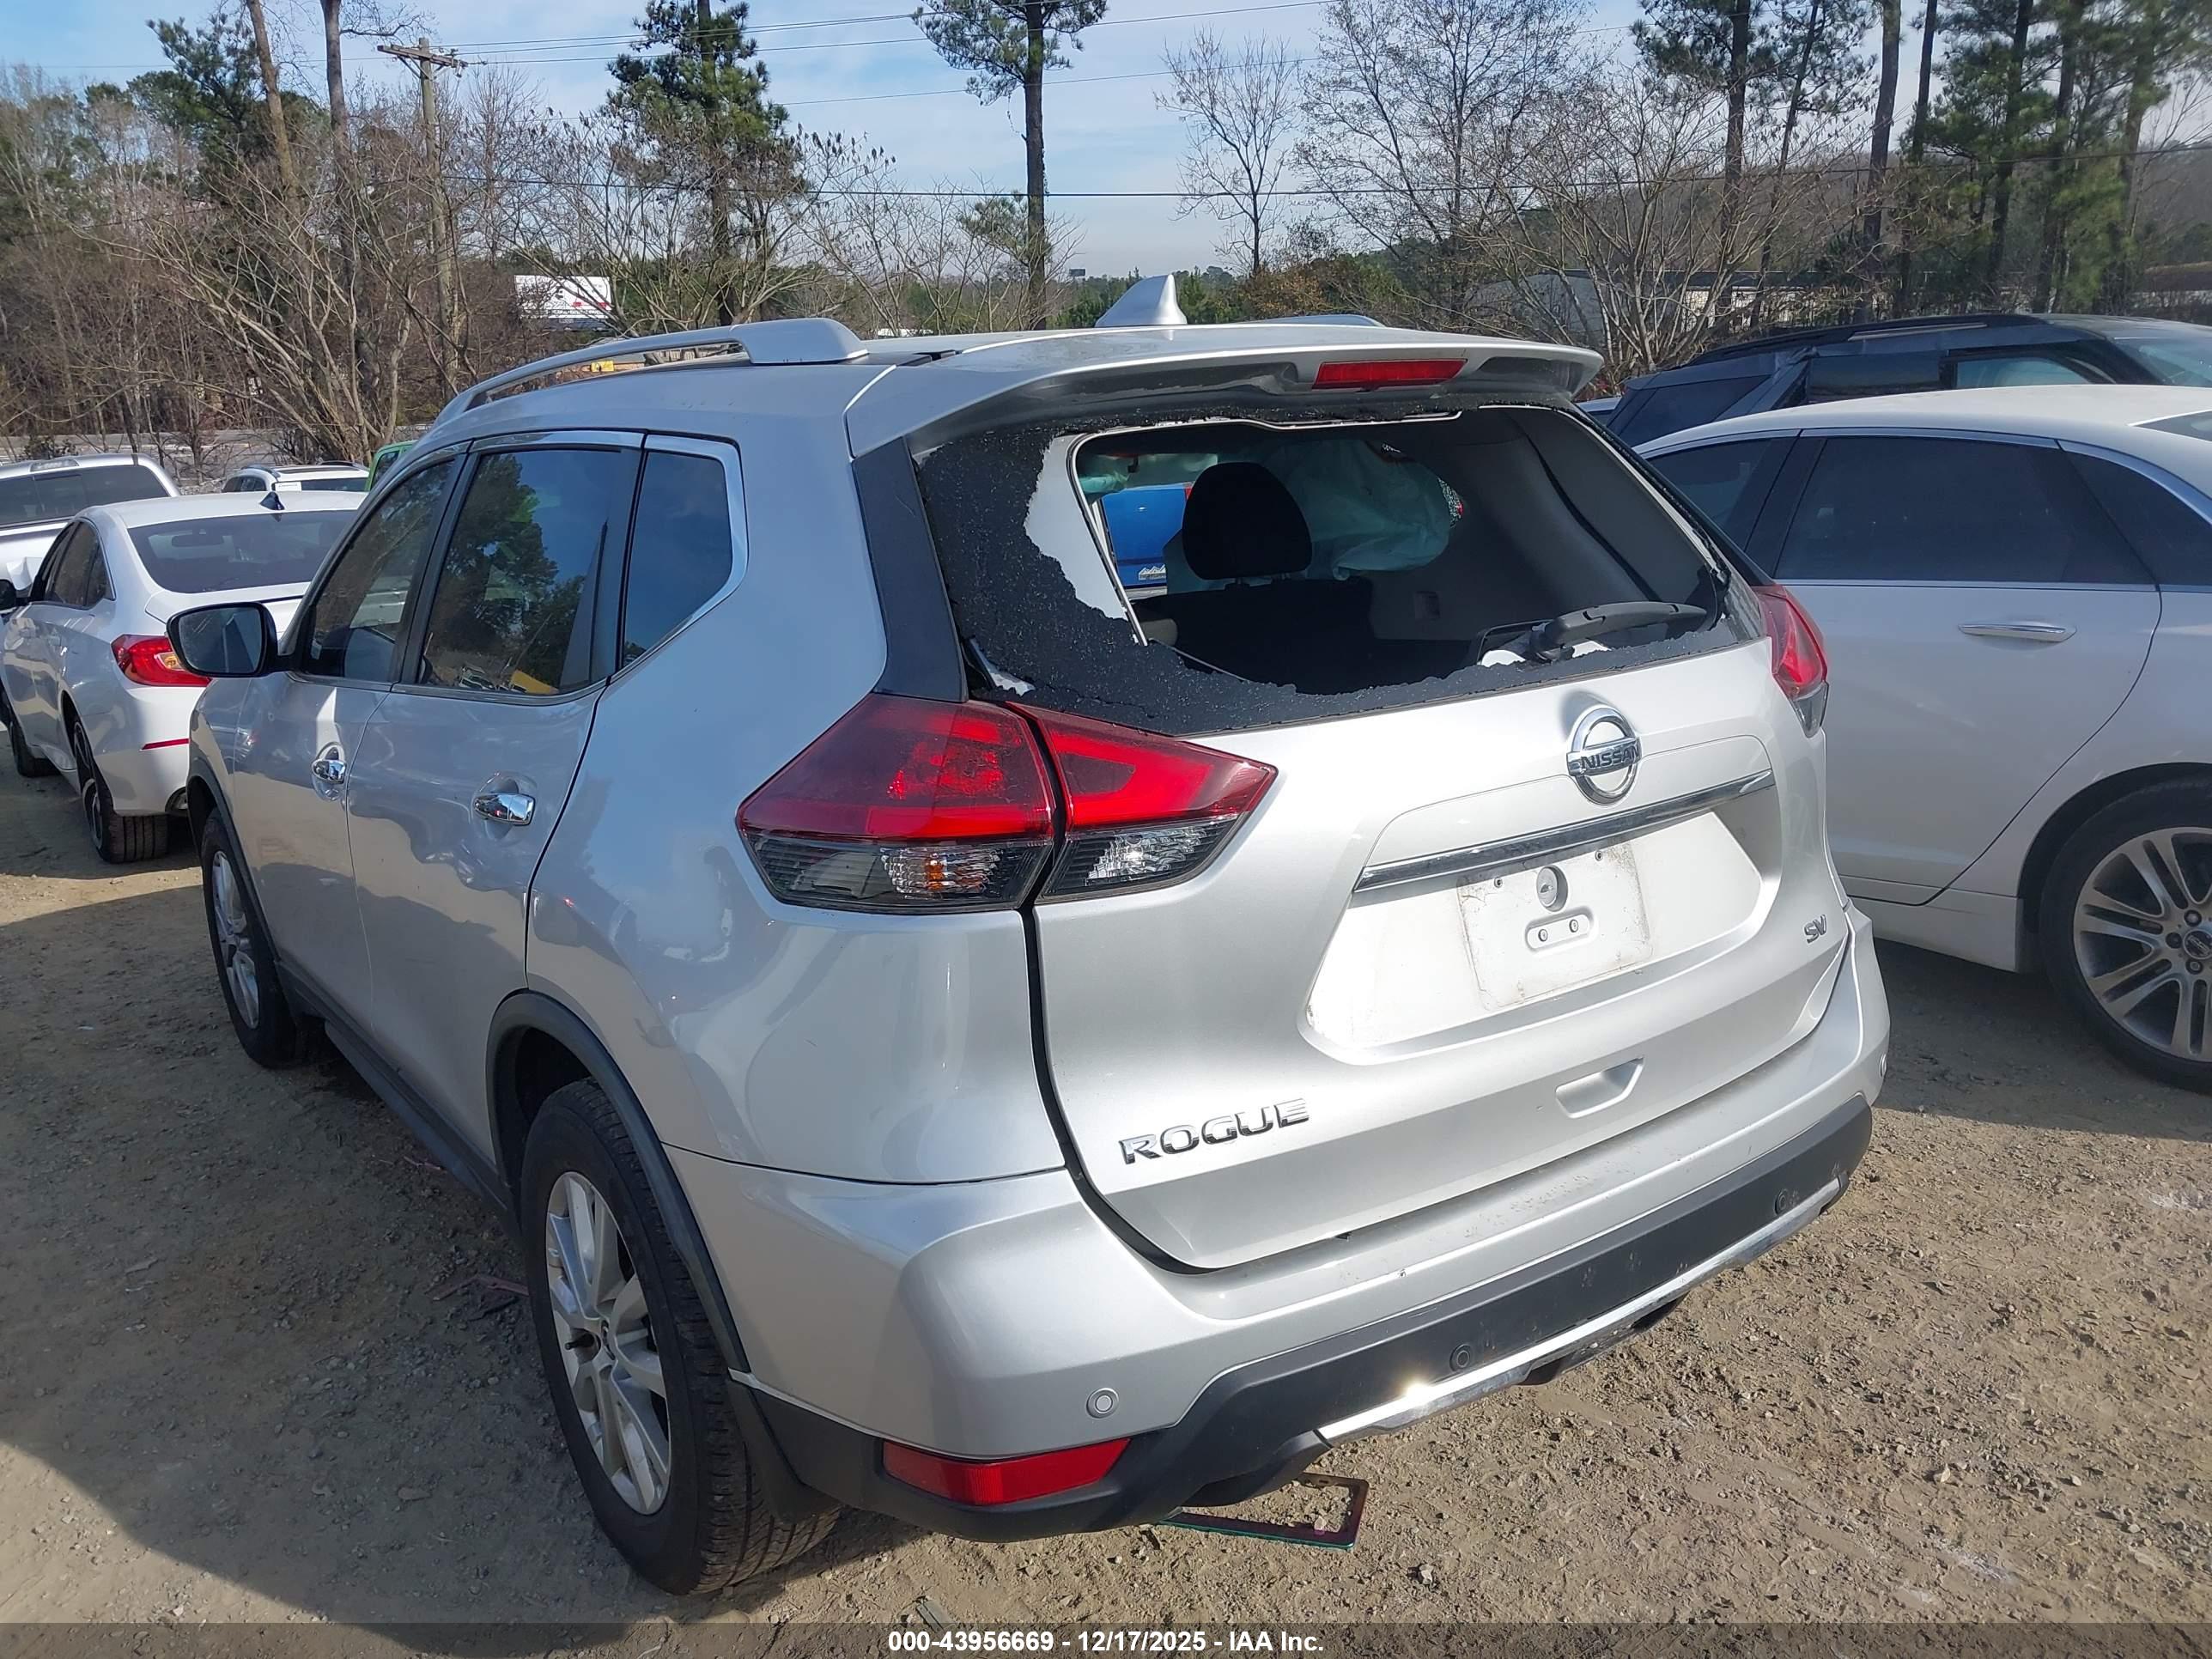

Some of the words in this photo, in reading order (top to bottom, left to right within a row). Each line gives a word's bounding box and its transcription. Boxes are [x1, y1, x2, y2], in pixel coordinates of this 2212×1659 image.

[1580, 744, 1639, 769] NISSAN
[1803, 914, 1827, 944] SV
[1118, 1097, 1310, 1165] ROGUE
